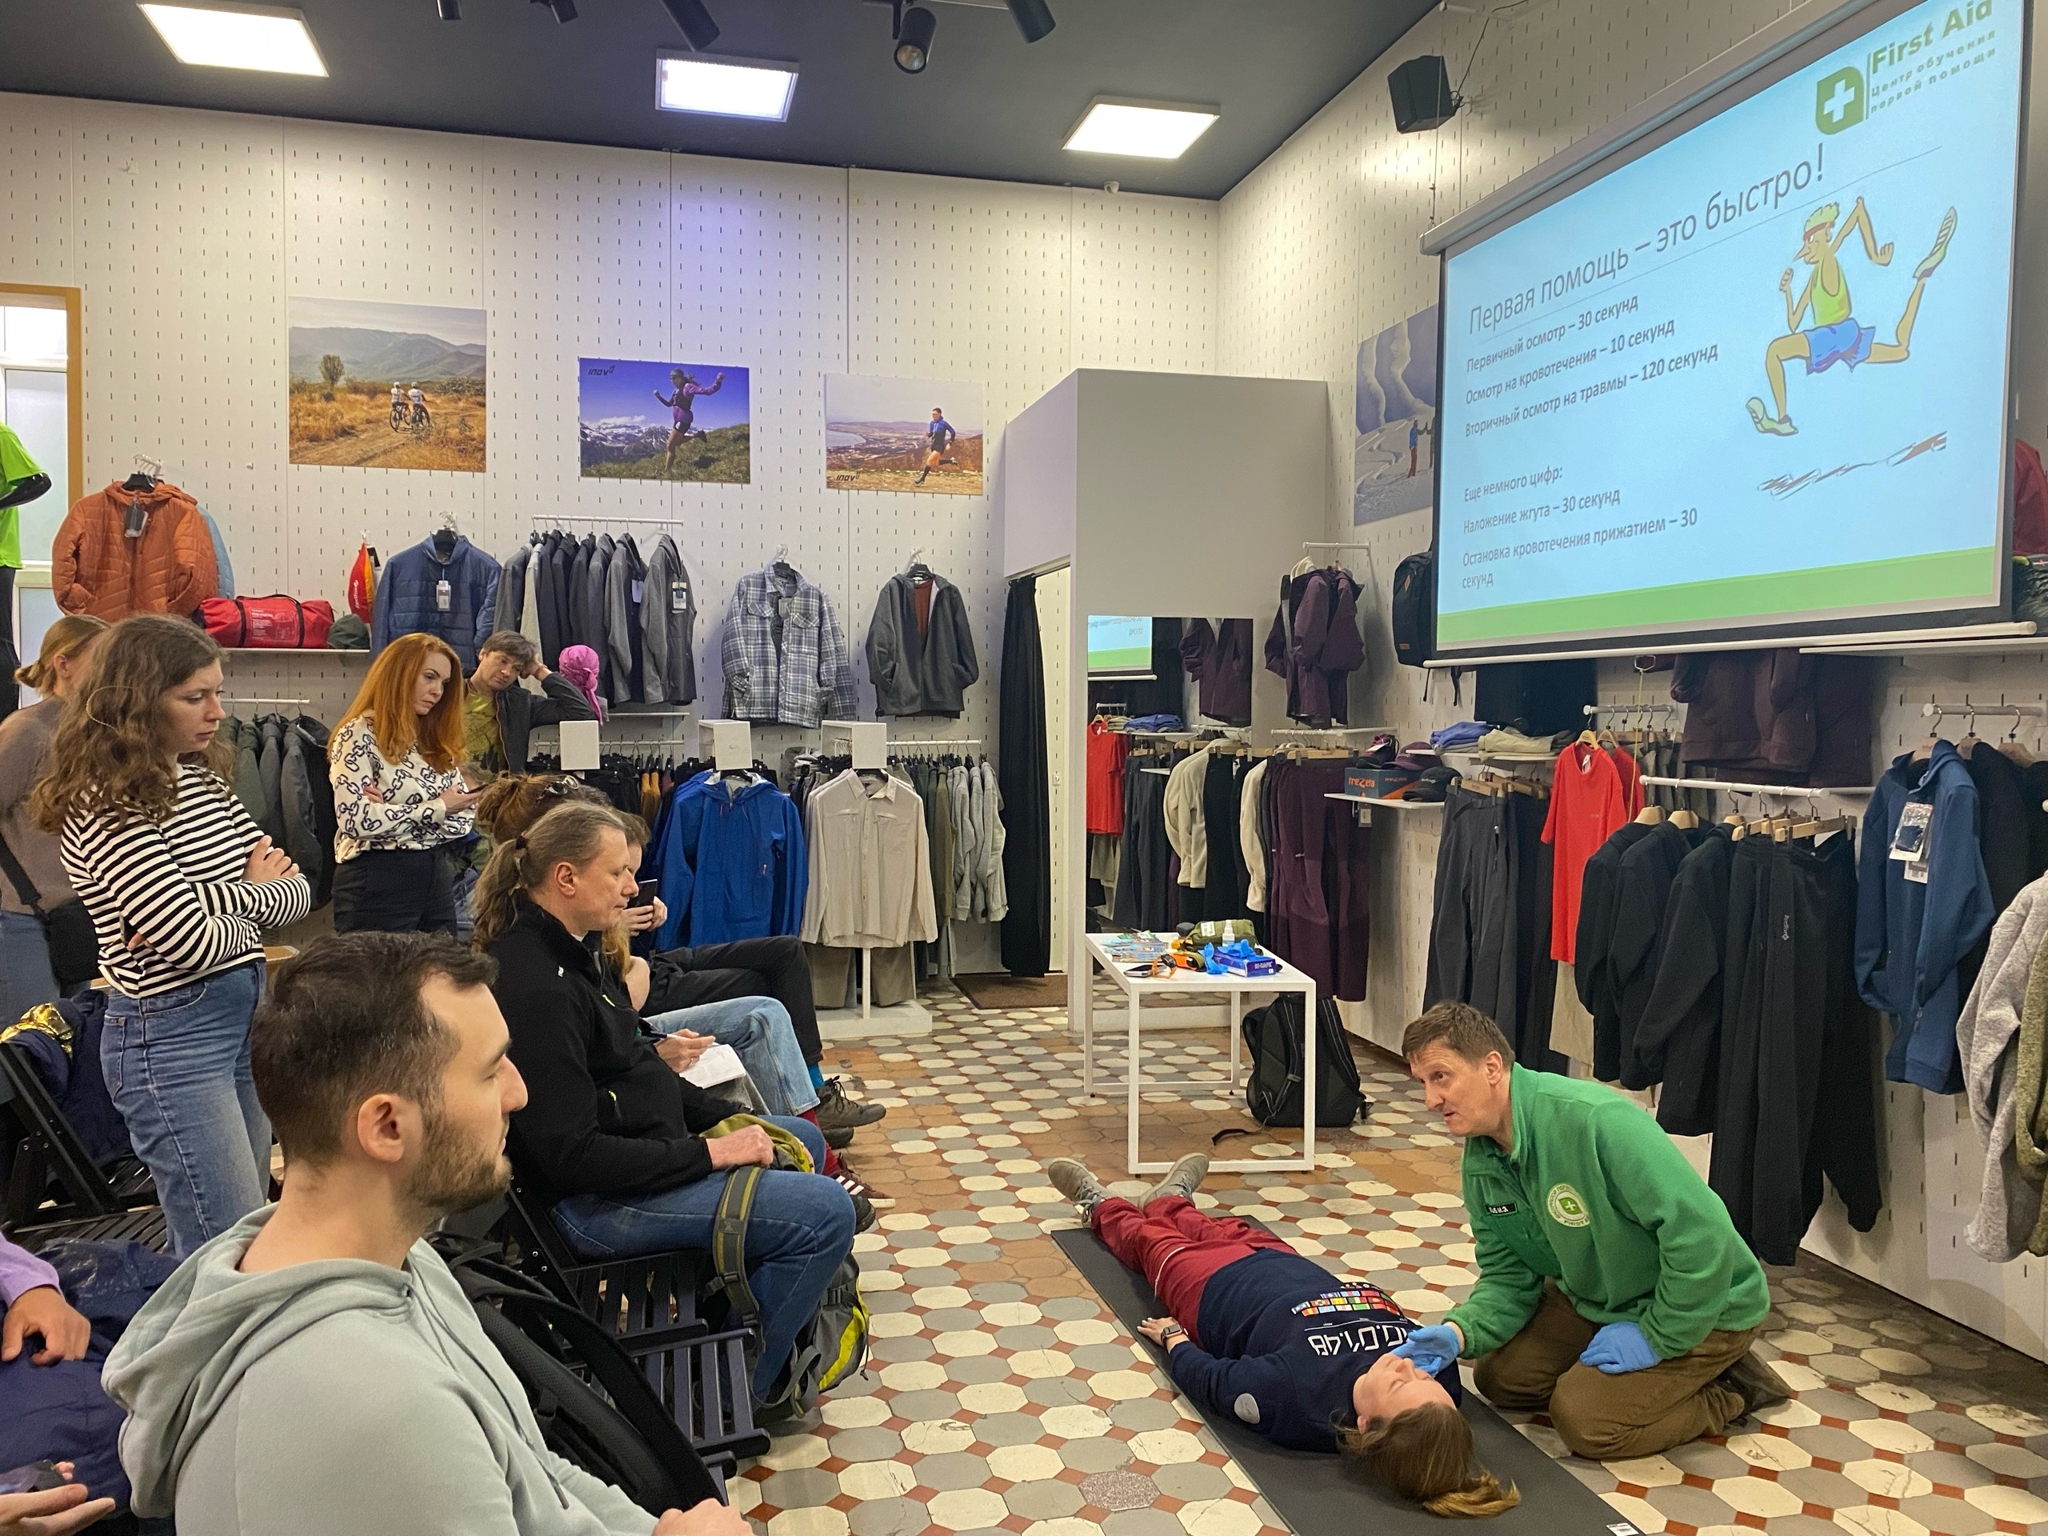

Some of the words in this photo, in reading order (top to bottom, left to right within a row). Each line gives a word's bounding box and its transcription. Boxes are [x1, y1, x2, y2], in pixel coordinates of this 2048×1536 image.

[1871, 71, 1912, 97] Центр
[1917, 30, 1995, 73] обучения
[1872, 22, 1933, 74] First
[1942, 0, 1992, 38] Aid
[1871, 81, 1922, 113] первой
[1929, 49, 1996, 85] помощи
[1469, 286, 1535, 335] Первая
[1541, 248, 1629, 304] помощь
[1657, 213, 1697, 253] это
[1705, 142, 1824, 230] быстро!
[1466, 381, 1503, 405] Осмотр
[1505, 378, 1517, 391] на
[1519, 348, 1597, 389] кровотечения
[1611, 334, 1625, 355] 10
[1628, 318, 1675, 348] секунд
[1467, 337, 1524, 373] Первичный
[1526, 324, 1566, 351] осмотр
[1578, 313, 1592, 331] 30
[1595, 295, 1639, 323] секунд
[1465, 406, 1520, 437] Вторичный
[1522, 396, 1560, 420] осмотр
[1563, 391, 1577, 406] на
[1580, 373, 1627, 403] травмы
[1641, 360, 1665, 382] 120
[1668, 343, 1718, 373] секунд
[1463, 511, 1517, 535] Наложение
[1519, 504, 1550, 524] жгута
[1562, 495, 1576, 513] 30
[1578, 488, 1620, 510] секунд
[1464, 487, 1482, 502] Еще
[1483, 474, 1528, 496] немного
[1529, 465, 1563, 489] цифр:
[1463, 545, 1511, 567] Остановка
[1513, 530, 1590, 559] кровотечения
[1593, 517, 1666, 546] прижатием
[1681, 507, 1698, 528] 30
[1462, 571, 1494, 589] секунд
